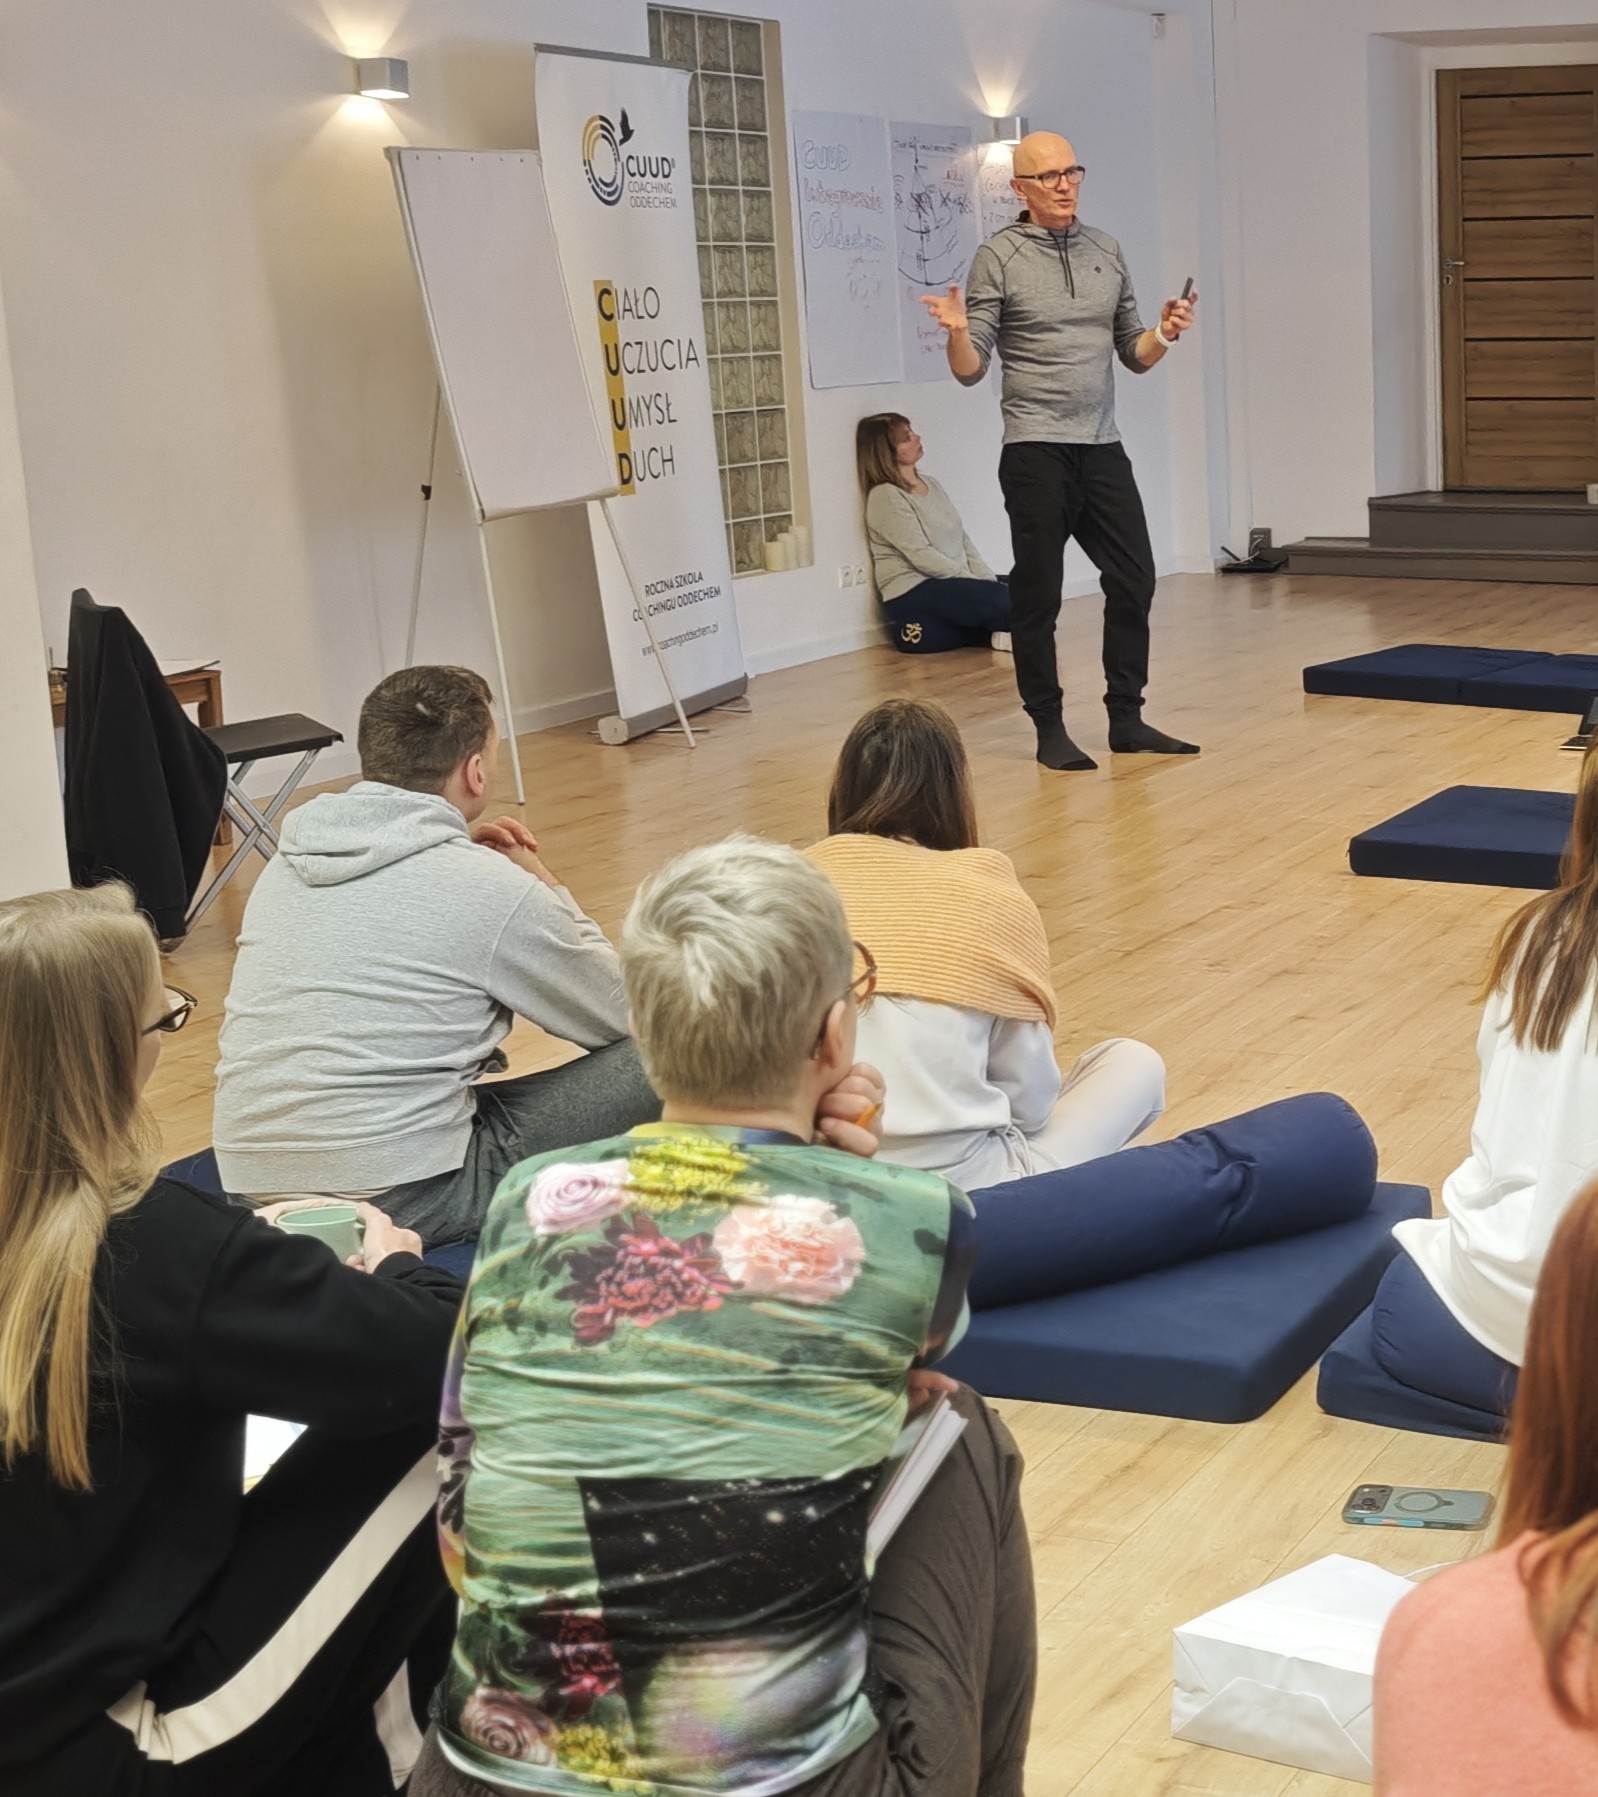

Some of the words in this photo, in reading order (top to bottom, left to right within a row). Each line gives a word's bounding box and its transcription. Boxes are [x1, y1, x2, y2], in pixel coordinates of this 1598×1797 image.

[628, 181, 673, 194] COACHING
[630, 196, 678, 208] ODDECHEM
[598, 286, 660, 321] CIAŁO
[604, 338, 700, 376] UCZUCIA
[611, 392, 678, 431] UMYSŁ
[618, 444, 675, 485] DUCH
[645, 579, 675, 597] ROCZNA
[677, 585, 721, 608] ODDECHEM
[641, 620, 719, 656] wwcoachingoddechem.pl
